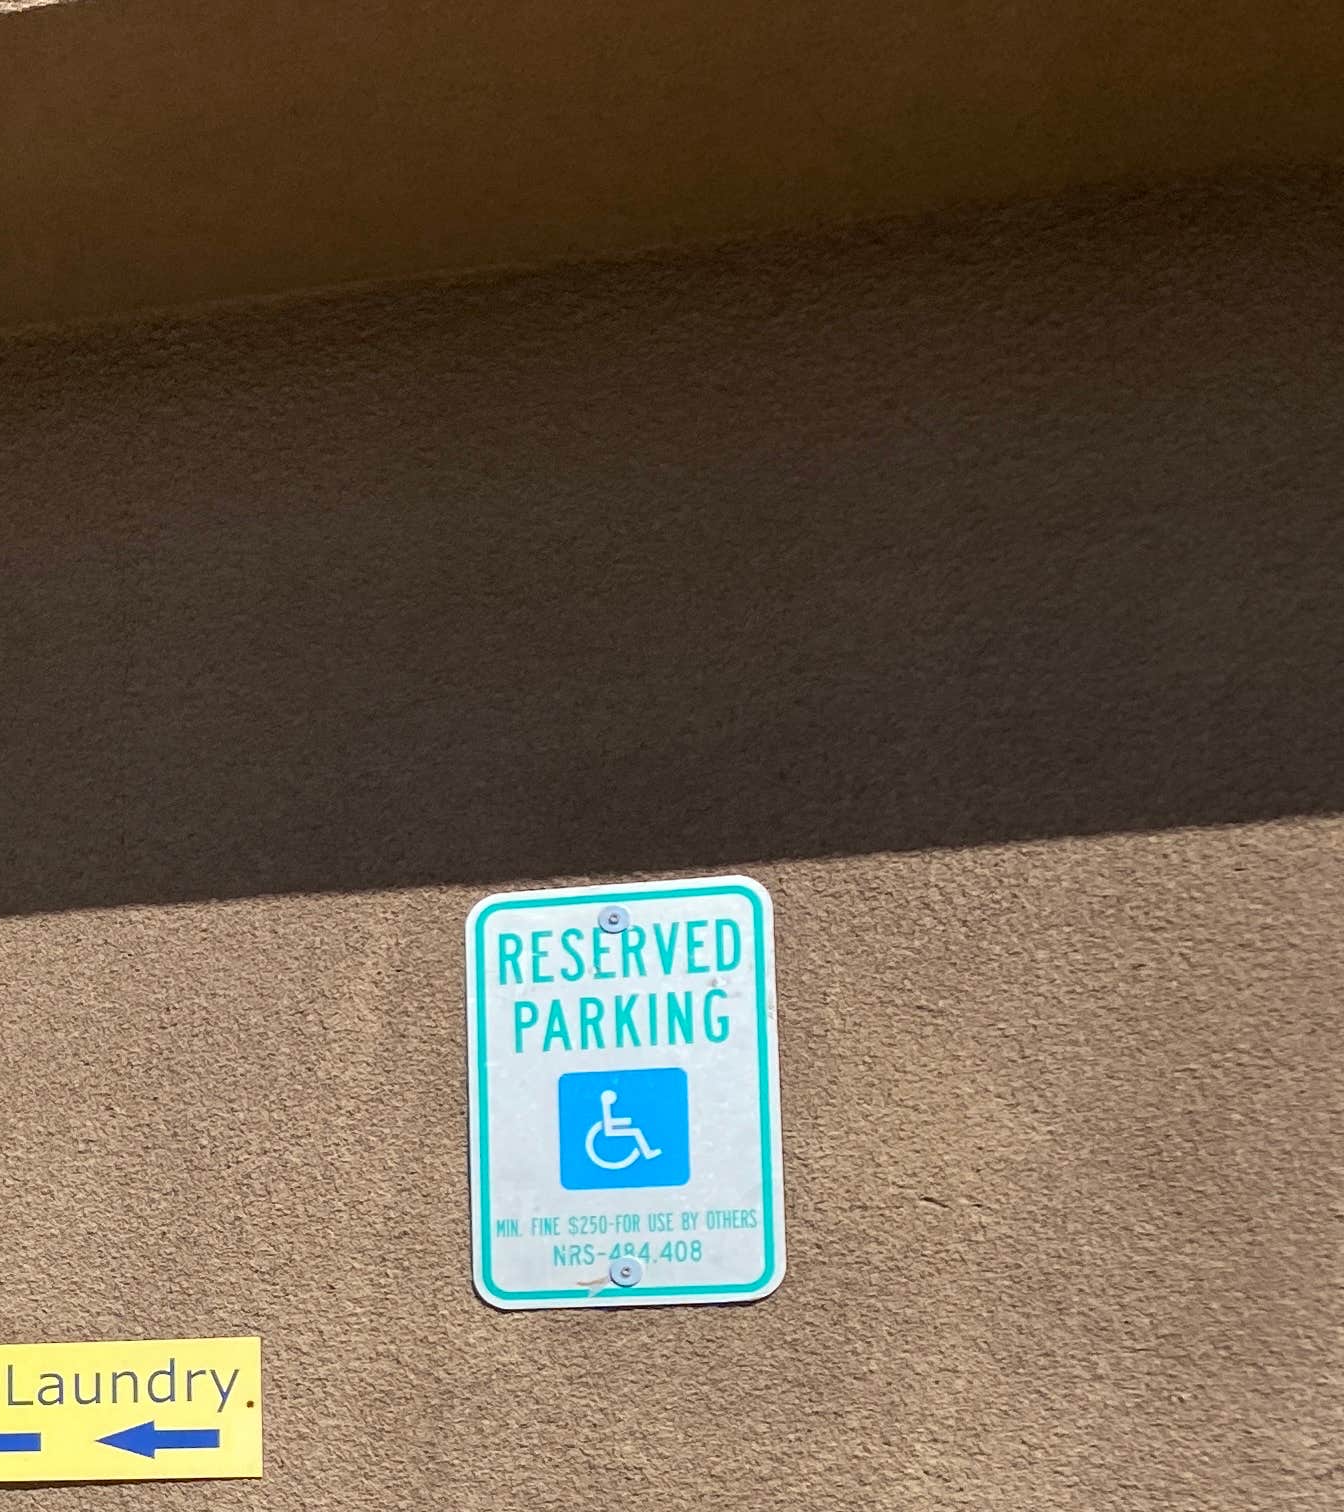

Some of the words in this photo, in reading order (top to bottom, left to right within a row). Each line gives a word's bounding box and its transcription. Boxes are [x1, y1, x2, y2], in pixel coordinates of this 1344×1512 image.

[498, 918, 743, 985] RESERVED
[515, 988, 730, 1053] PARKING
[496, 1219, 523, 1238] MIN.
[531, 1216, 560, 1236] FINE
[648, 1212, 674, 1232] USE
[681, 1211, 699, 1231] BY
[706, 1209, 758, 1230] OTHERS
[7, 1357, 240, 1413] Laundry
